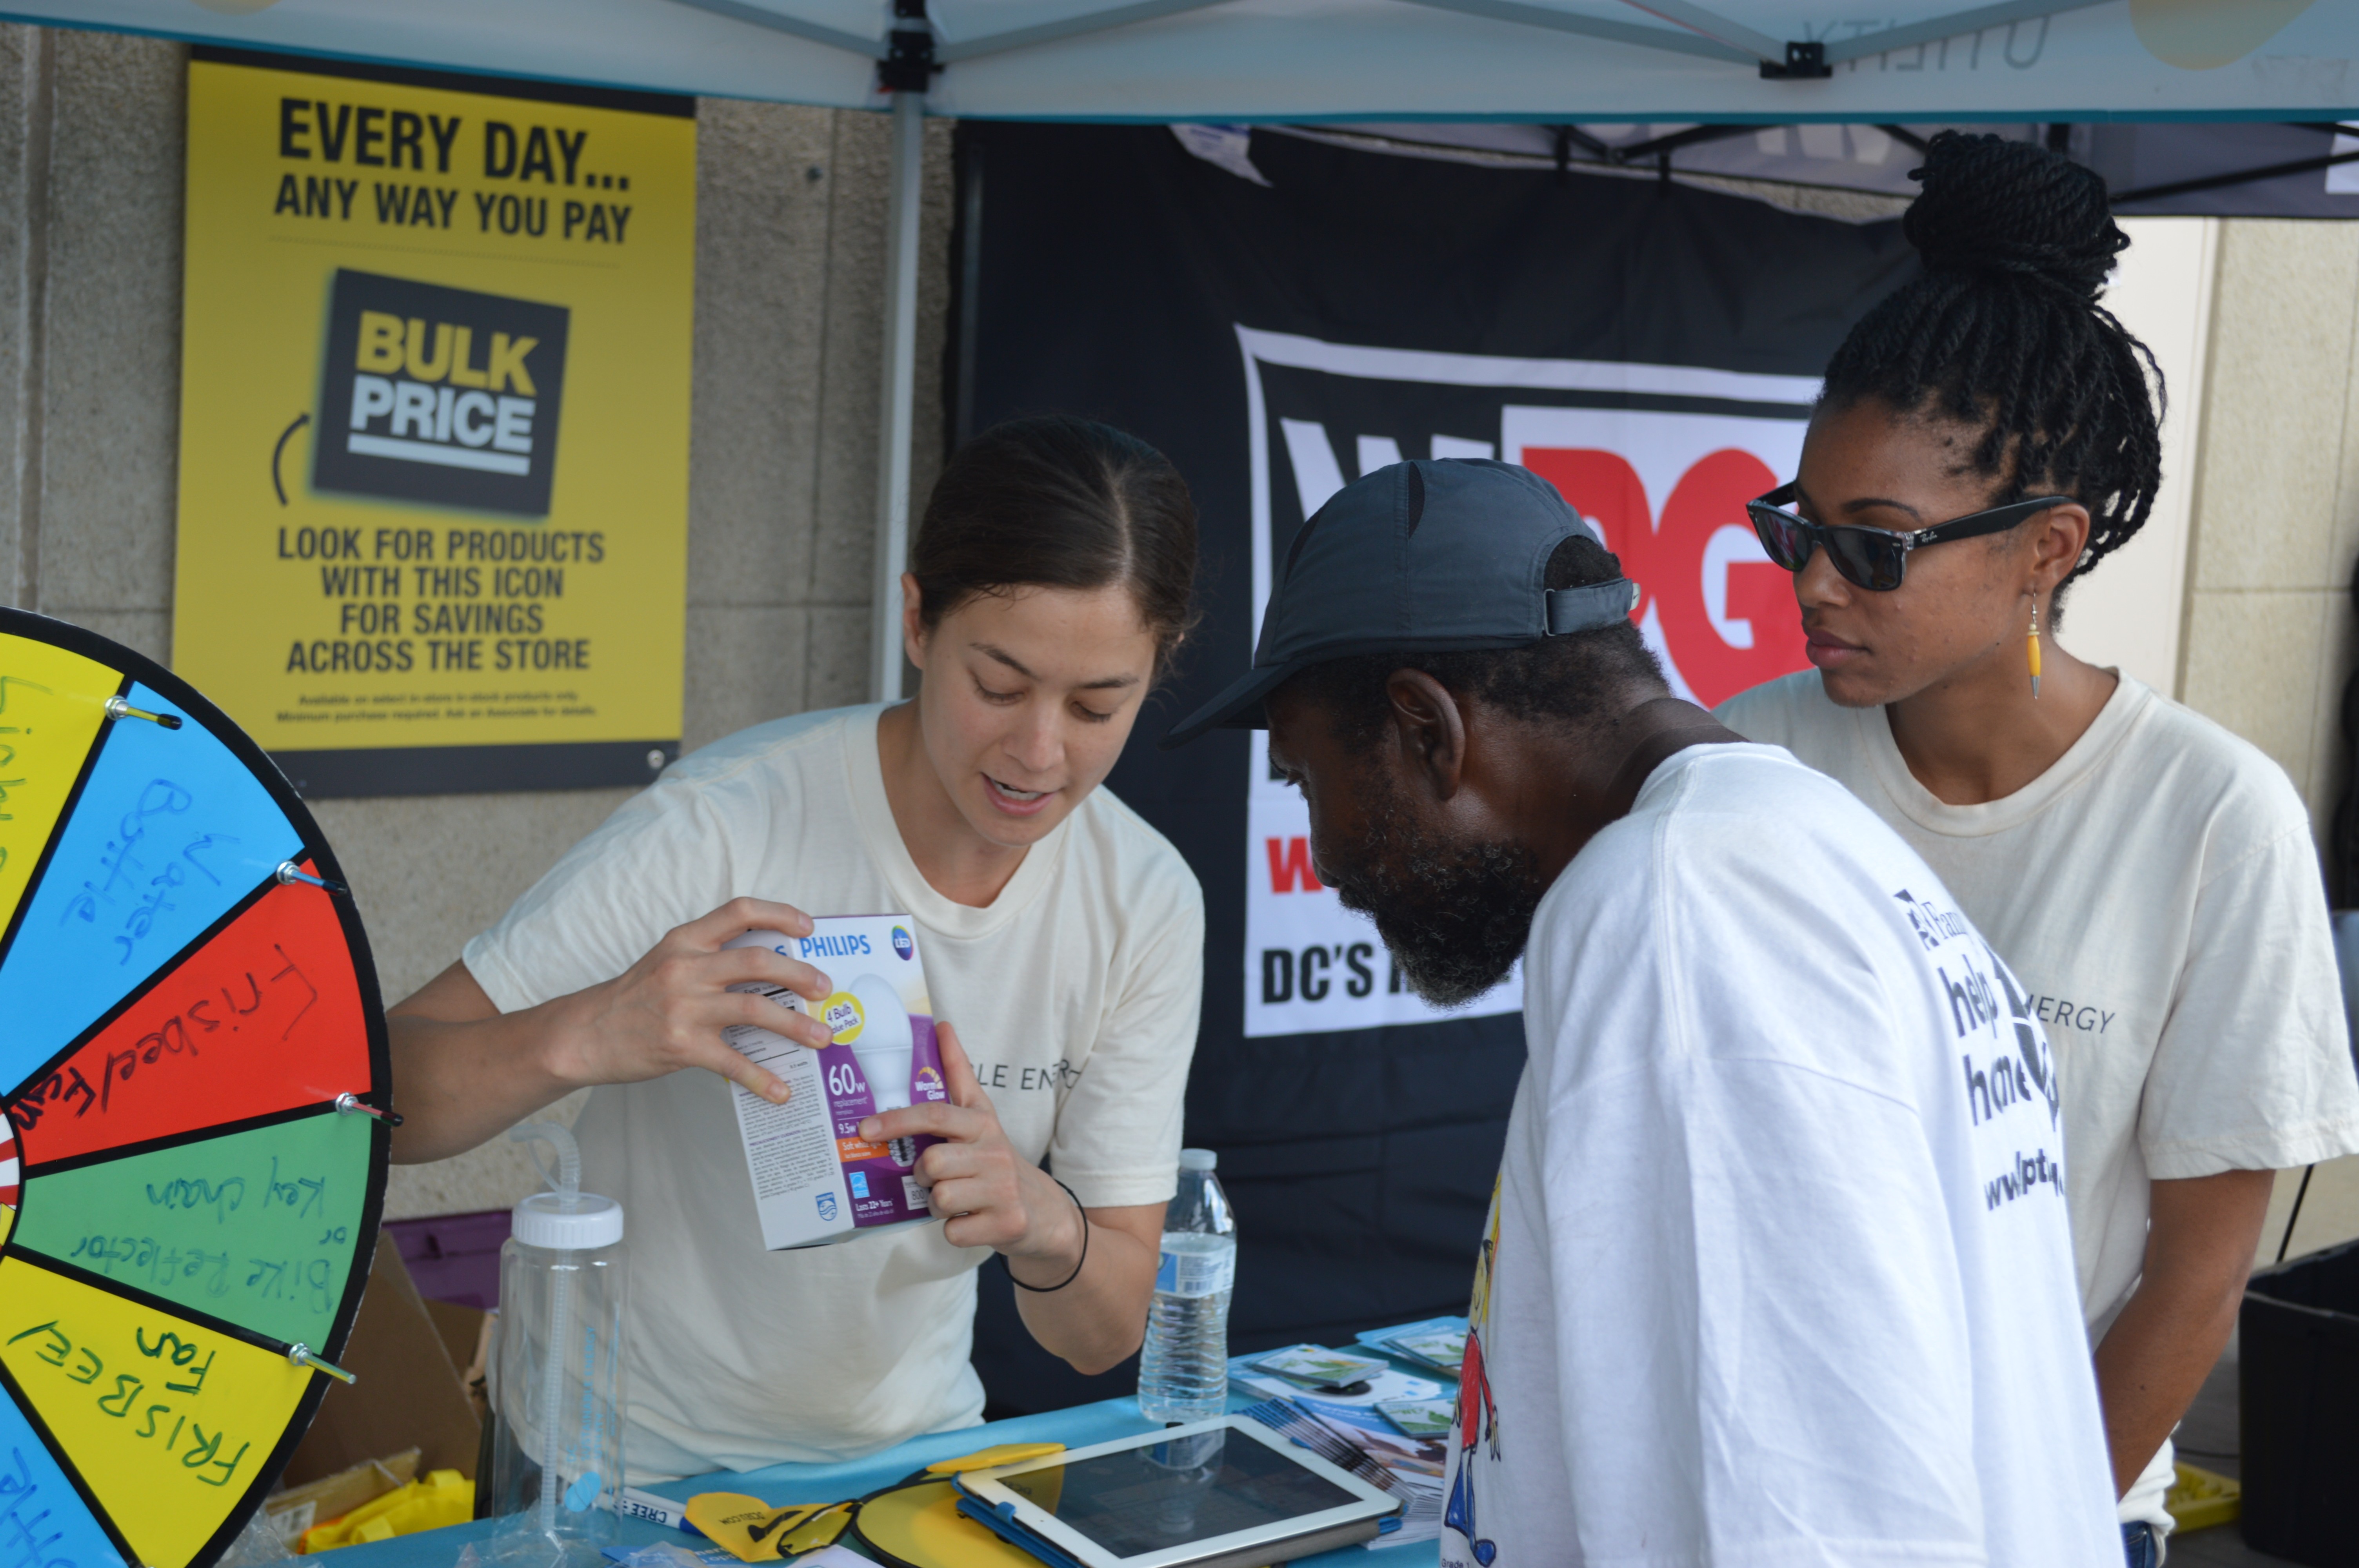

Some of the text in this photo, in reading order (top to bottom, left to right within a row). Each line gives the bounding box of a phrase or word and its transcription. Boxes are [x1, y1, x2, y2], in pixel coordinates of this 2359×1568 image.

[279, 97, 630, 191] EVERY DAY...
[274, 174, 632, 243] ANY WAY YOU PAY
[356, 310, 539, 396] BULK
[350, 374, 535, 453] PRICE
[278, 527, 604, 563] LOOK FOR PRODUCTS
[322, 566, 564, 598] WITH THIS ICON
[341, 603, 543, 635] FOR SAVINGS
[287, 639, 590, 673] ACROSS THE STORE
[58, 778, 193, 927] Bottle
[114, 830, 241, 966] Water
[799, 935, 871, 958] PHILIPS
[894, 938, 911, 949] LED
[1262, 943, 1373, 1004] DC'S
[827, 1003, 852, 1022] 4 Bulb
[1937, 953, 1998, 1039] help
[832, 1016, 859, 1034] alue Pack
[926, 1089, 945, 1100] Glow
[263, 1155, 326, 1219] Key
[318, 1226, 347, 1246] or
[70, 1236, 231, 1299] Reflector
[136, 1326, 217, 1396] Fan
[580, 1326, 596, 1462] SUSTAINABLE ENERGY
[566, 1444, 577, 1463] DC
[631, 1503, 667, 1524] CREE
[1441, 1558, 1464, 1568] Grade
